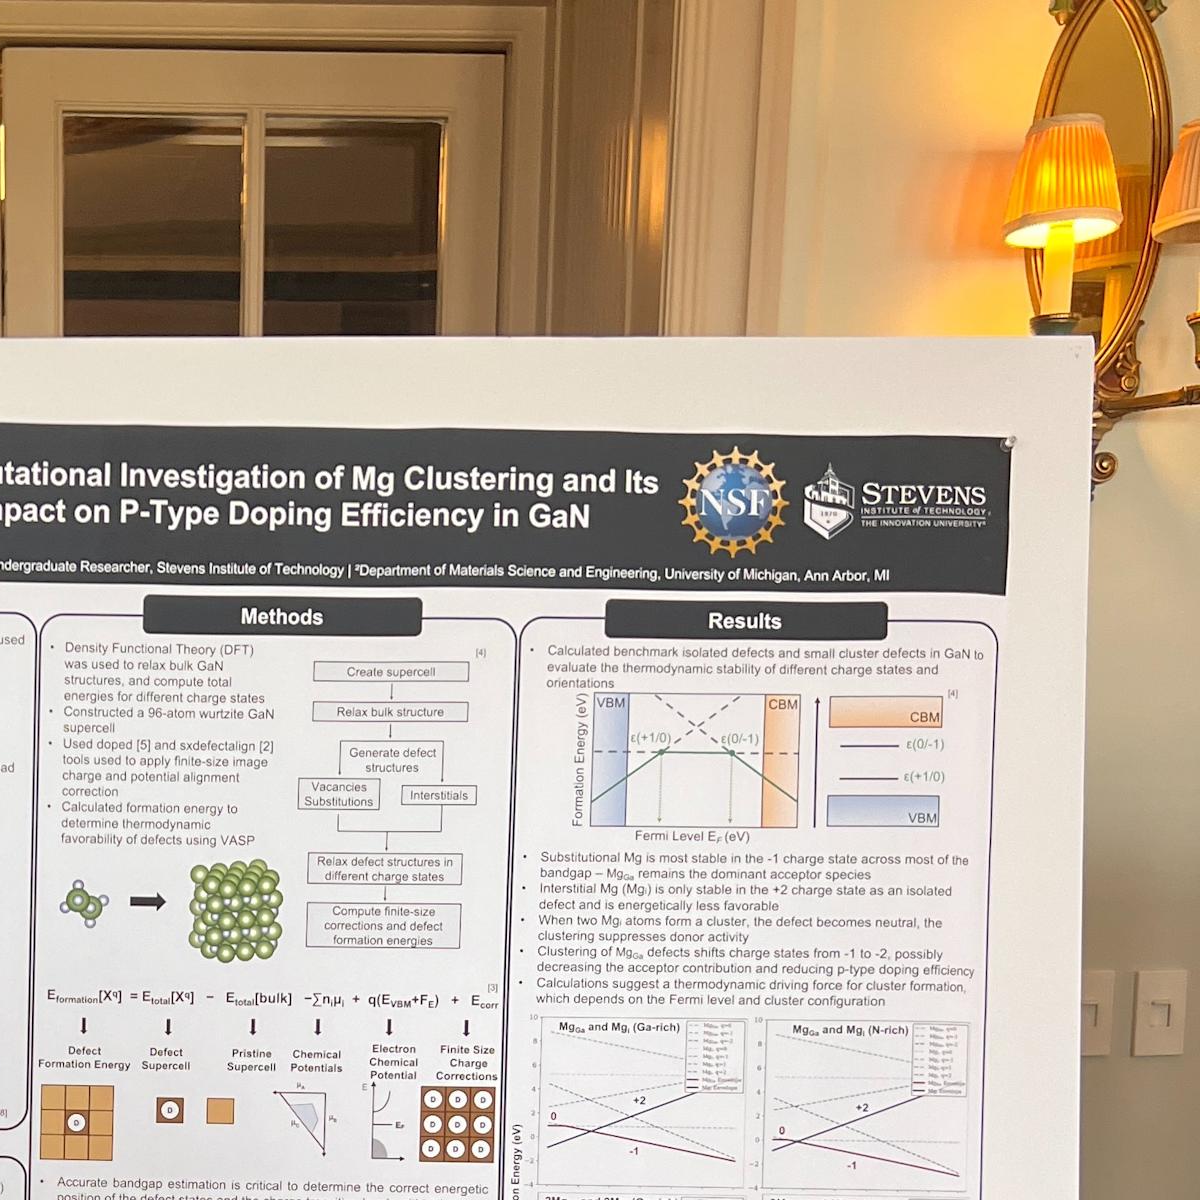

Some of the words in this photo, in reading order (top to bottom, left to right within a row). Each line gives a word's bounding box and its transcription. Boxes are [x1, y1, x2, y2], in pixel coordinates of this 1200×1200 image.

[120, 462, 305, 495] Investigation
[314, 464, 345, 490] of
[352, 465, 394, 497] Mg
[403, 465, 553, 498] Clustering
[562, 468, 615, 493] and
[624, 468, 659, 494] Its
[700, 488, 770, 516] NSF
[860, 482, 987, 509] STEVENS
[73, 504, 110, 523] on
[119, 498, 219, 527] P-Type
[228, 500, 331, 532] Doping
[341, 501, 484, 533] Efficiency
[493, 502, 518, 527] in
[528, 502, 589, 528] GaN
[912, 506, 921, 514] of
[924, 508, 986, 516] TECHNOLOGY
[880, 520, 932, 528] INNOVATION
[79, 560, 153, 575] Researcher,
[156, 560, 205, 575] Stevens
[208, 561, 256, 575] Institute
[258, 562, 272, 575] of
[273, 562, 344, 579] Technology
[433, 563, 447, 576] of
[448, 563, 504, 576] Materials
[507, 564, 556, 577] Science
[558, 565, 582, 578] and
[585, 564, 661, 584] Engineering,
[664, 567, 725, 583] University
[727, 567, 741, 580] of
[742, 567, 800, 583] Michigan,
[803, 569, 829, 581] Ann
[831, 569, 870, 583] Arbor,
[873, 568, 889, 581] MI
[241, 607, 323, 626] Methods
[708, 612, 782, 630] Results
[64, 641, 108, 656] Density
[112, 642, 171, 654] Functional
[175, 643, 216, 658] Theory
[219, 644, 253, 658] (DFT)
[547, 644, 609, 656] Calculated
[613, 645, 678, 657] benchmark
[682, 647, 727, 658] isolated
[731, 646, 774, 658] defects
[778, 647, 800, 658] and
[803, 648, 835, 659] small
[838, 647, 879, 659] cluster
[882, 647, 926, 659] defects
[929, 647, 940, 659] in
[943, 647, 970, 659] GaN
[973, 650, 984, 660] to
[64, 660, 87, 669] was
[91, 659, 119, 670] used
[123, 659, 134, 670] to
[137, 659, 165, 670] relax
[169, 660, 193, 671] bulk
[196, 660, 223, 671] GaN
[346, 666, 384, 677] Create
[386, 667, 436, 678] supercell
[576, 693, 588, 712] (eV)
[335, 706, 367, 717] Relax
[371, 706, 393, 717] bulk
[396, 707, 446, 717] structure
[574, 713, 588, 761] Energy
[311, 781, 367, 792] Vacancies
[573, 764, 584, 826] Formation
[302, 796, 376, 809] Substitutions
[408, 790, 470, 804] Interstitials
[635, 829, 668, 841] Fermi
[672, 830, 703, 841] Level
